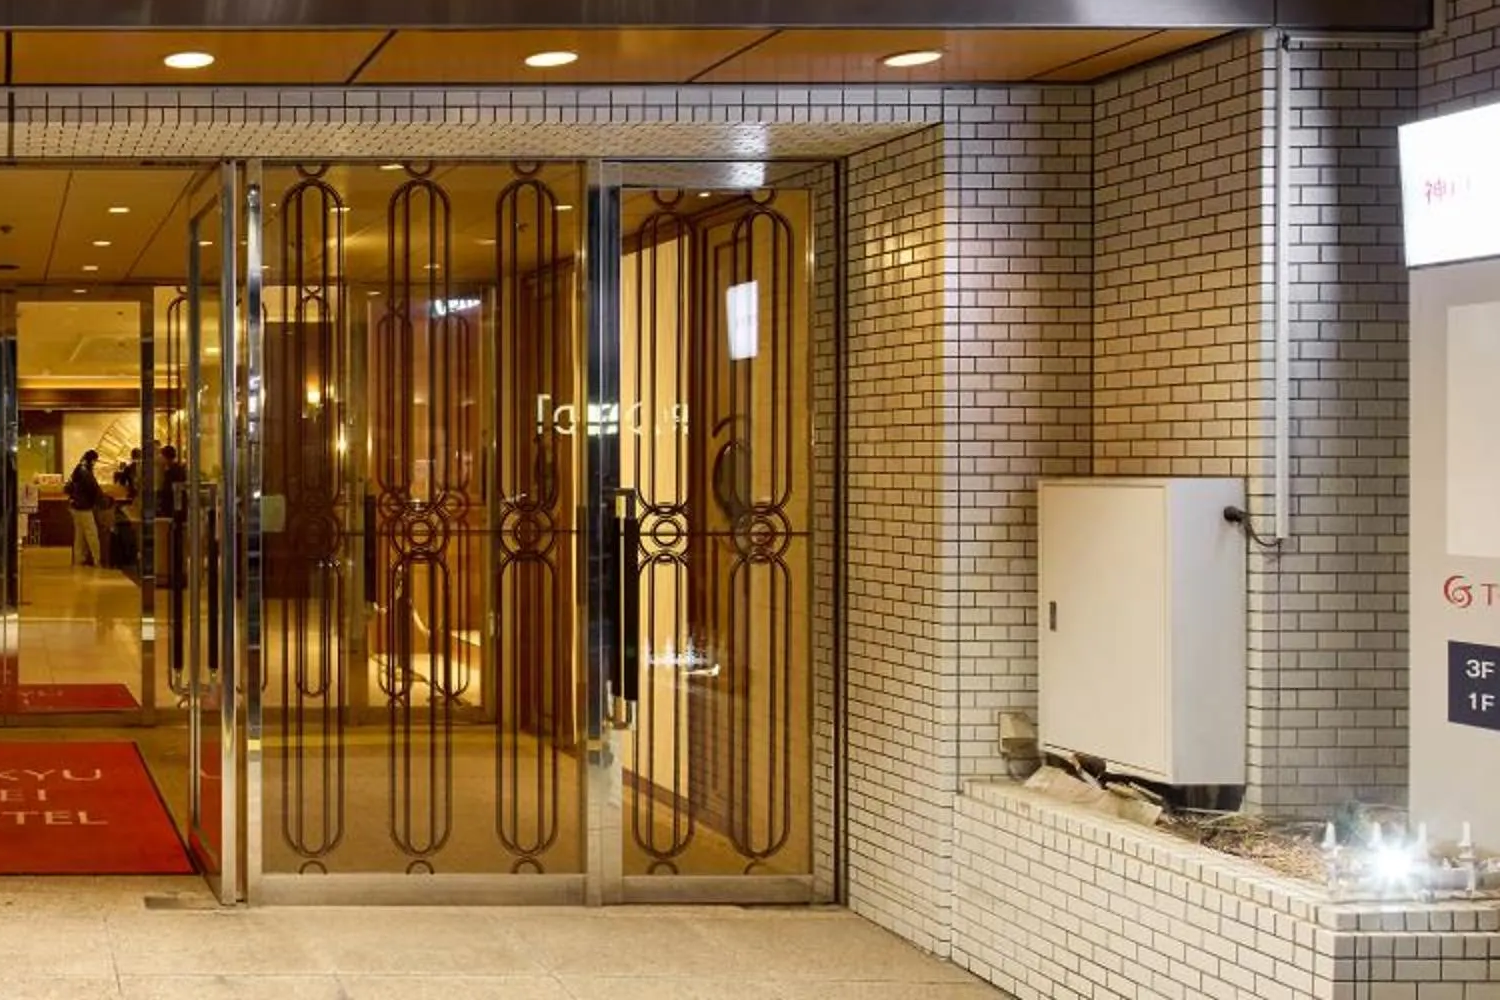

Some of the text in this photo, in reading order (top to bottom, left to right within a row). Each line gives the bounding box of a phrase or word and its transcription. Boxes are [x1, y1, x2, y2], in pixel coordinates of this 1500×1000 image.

[1481, 583, 1500, 606] T
[1465, 659, 1496, 679] 3F
[1467, 692, 1496, 712] 1F
